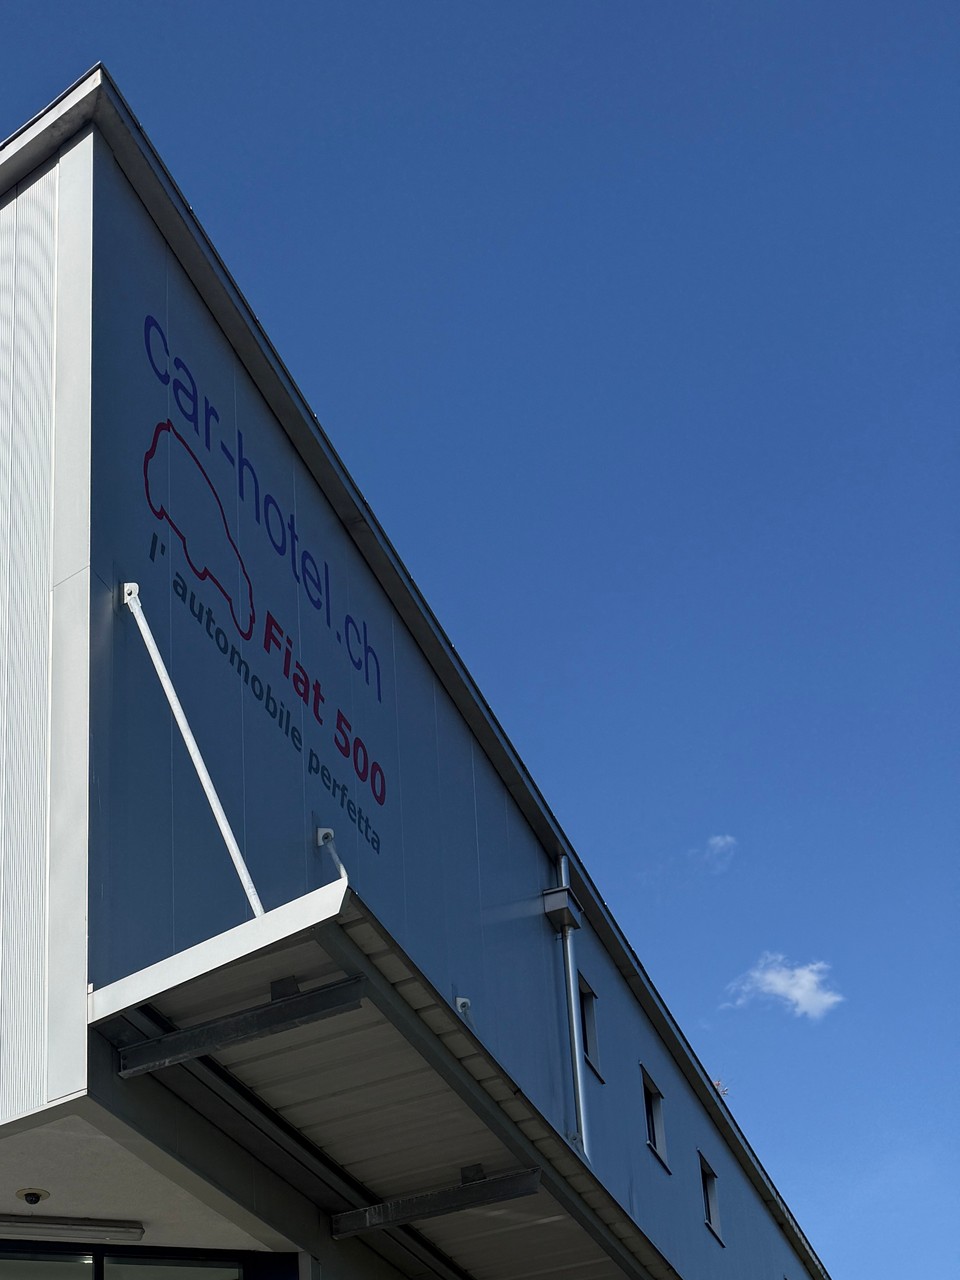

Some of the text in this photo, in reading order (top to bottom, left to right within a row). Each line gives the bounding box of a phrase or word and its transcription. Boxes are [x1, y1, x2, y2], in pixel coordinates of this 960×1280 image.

[144, 314, 382, 703] car-hotel.ch
[172, 571, 303, 752] automobile
[308, 745, 381, 855] perfetta
[263, 610, 387, 806] Fiat 500
